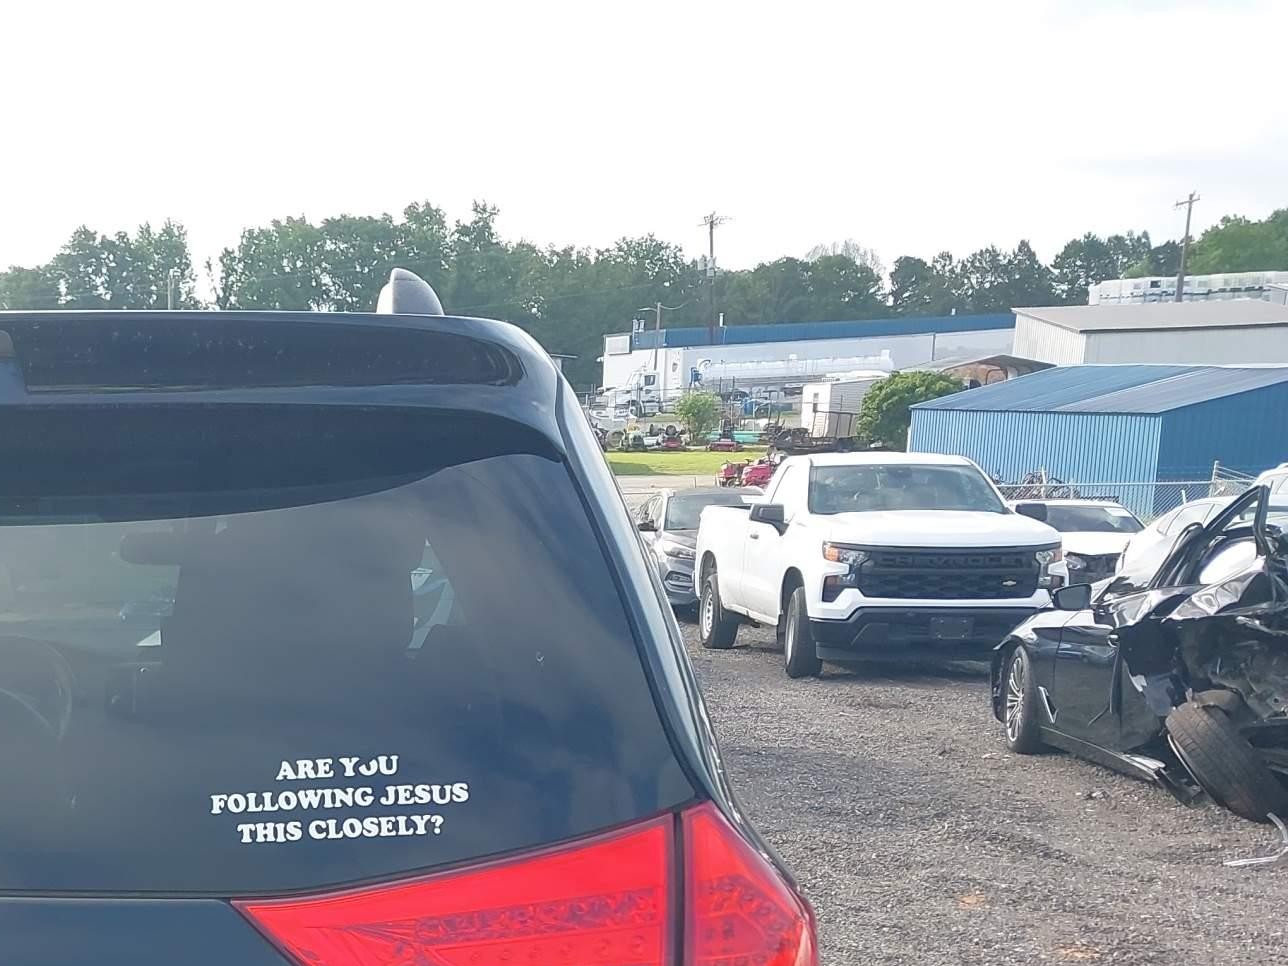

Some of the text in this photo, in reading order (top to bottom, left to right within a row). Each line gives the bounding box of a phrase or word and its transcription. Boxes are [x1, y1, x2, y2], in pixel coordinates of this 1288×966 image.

[275, 758, 333, 780] ARE
[210, 783, 469, 814] FOLLOWING JESUS
[237, 815, 444, 843] THIS CLOSELY?
